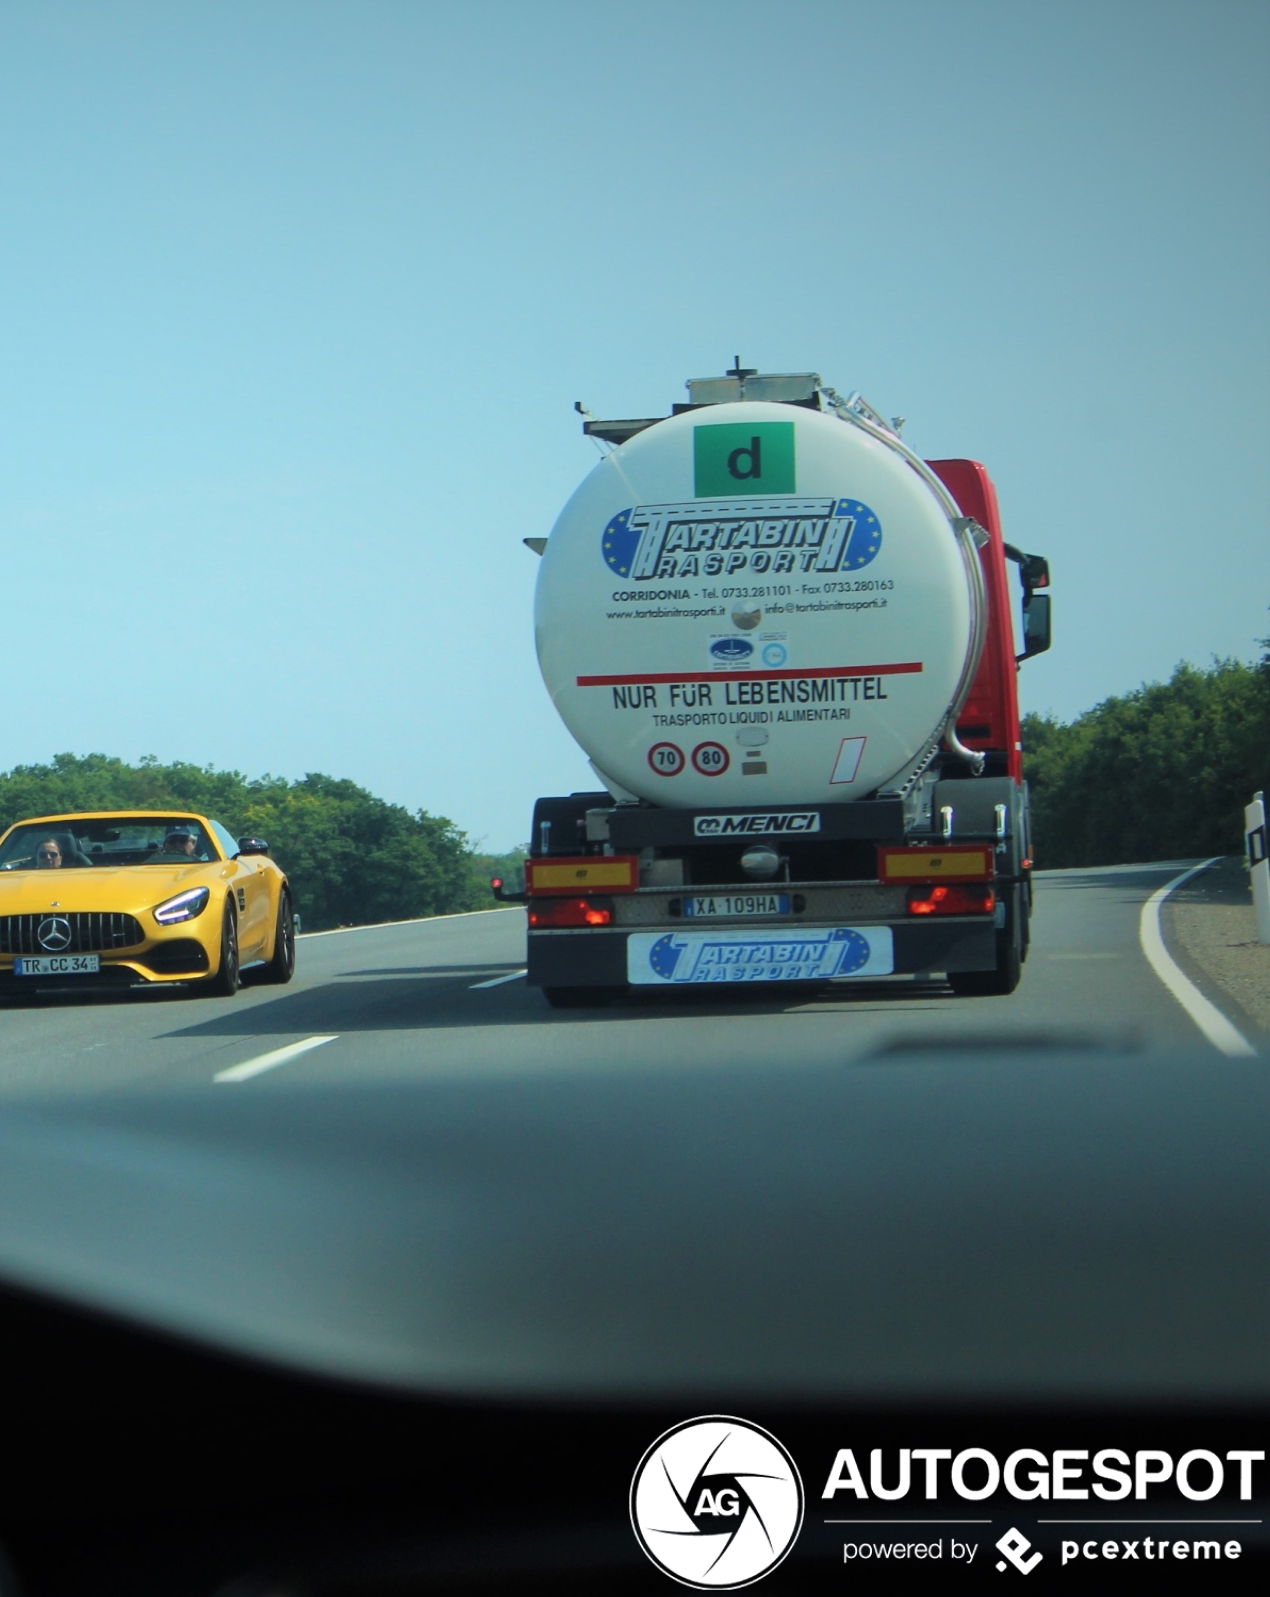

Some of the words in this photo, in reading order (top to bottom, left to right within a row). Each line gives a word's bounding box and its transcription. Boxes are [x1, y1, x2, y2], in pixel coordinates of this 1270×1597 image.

[727, 437, 762, 480] d
[612, 589, 691, 601] CORRIDONIA
[701, 588, 719, 599] Tel.
[721, 585, 792, 598] 0733.281101
[802, 584, 821, 595] Fax
[823, 580, 894, 593] 0733.280163
[606, 606, 726, 619] www.tartabinitrasporti.it
[613, 685, 657, 709] NUR
[726, 677, 887, 706] LEBENSMITTEL
[652, 712, 727, 727] TRASPORTO
[730, 711, 773, 724] LIQUIDI
[777, 708, 850, 723] ALIMENTARI
[658, 751, 676, 765] 70
[702, 751, 721, 765] 80
[721, 814, 817, 834] MENCI
[696, 897, 716, 915] XA
[725, 895, 778, 914] 109HA
[23, 959, 41, 973] TR
[50, 958, 69, 972] CC
[72, 957, 88, 971] 34
